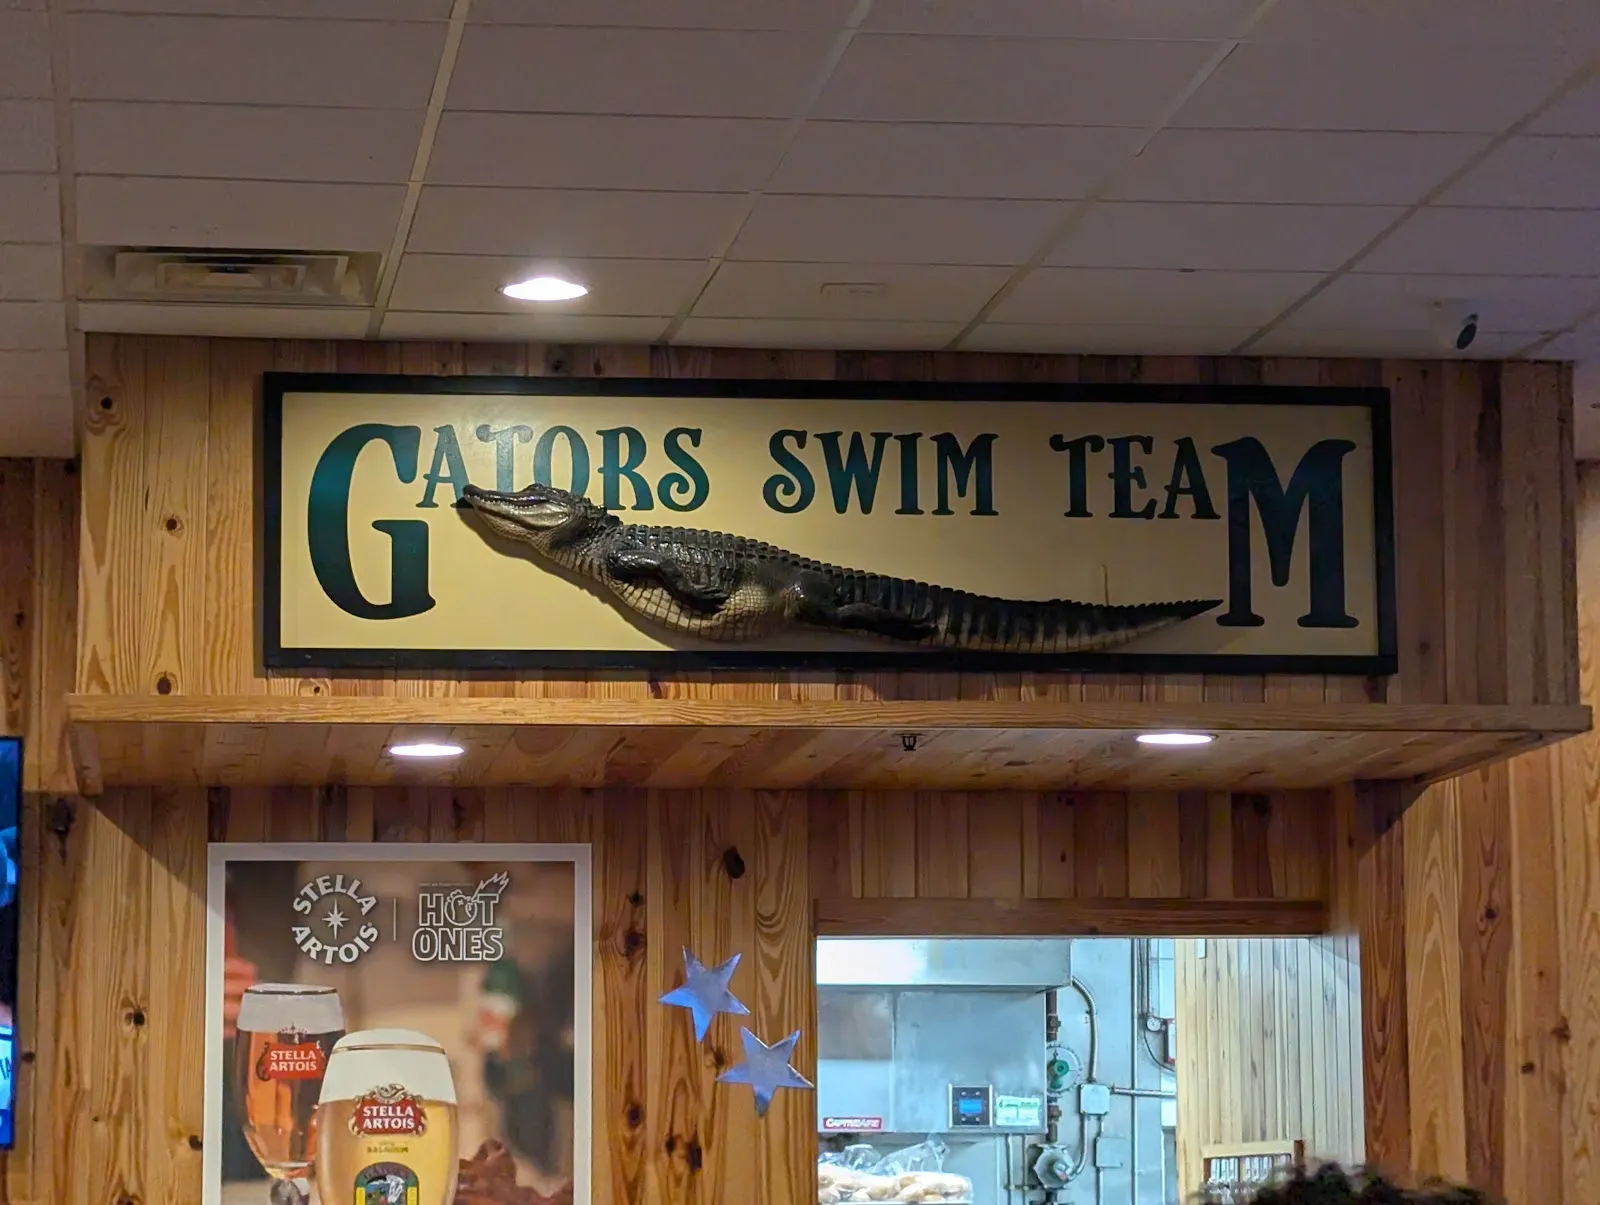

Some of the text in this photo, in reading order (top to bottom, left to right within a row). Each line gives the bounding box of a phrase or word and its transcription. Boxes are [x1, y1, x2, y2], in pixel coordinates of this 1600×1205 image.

[308, 423, 1358, 629] GATORS SWIM TEAM
[293, 874, 378, 916] STELLA
[418, 891, 501, 927] HOT
[291, 922, 378, 965] ARTOIS
[411, 927, 504, 962] ONES
[270, 1050, 316, 1060] STELLA
[270, 1061, 318, 1072] ARTOIS
[363, 1106, 415, 1117] STELLA
[363, 1117, 415, 1130] ARTOIS
